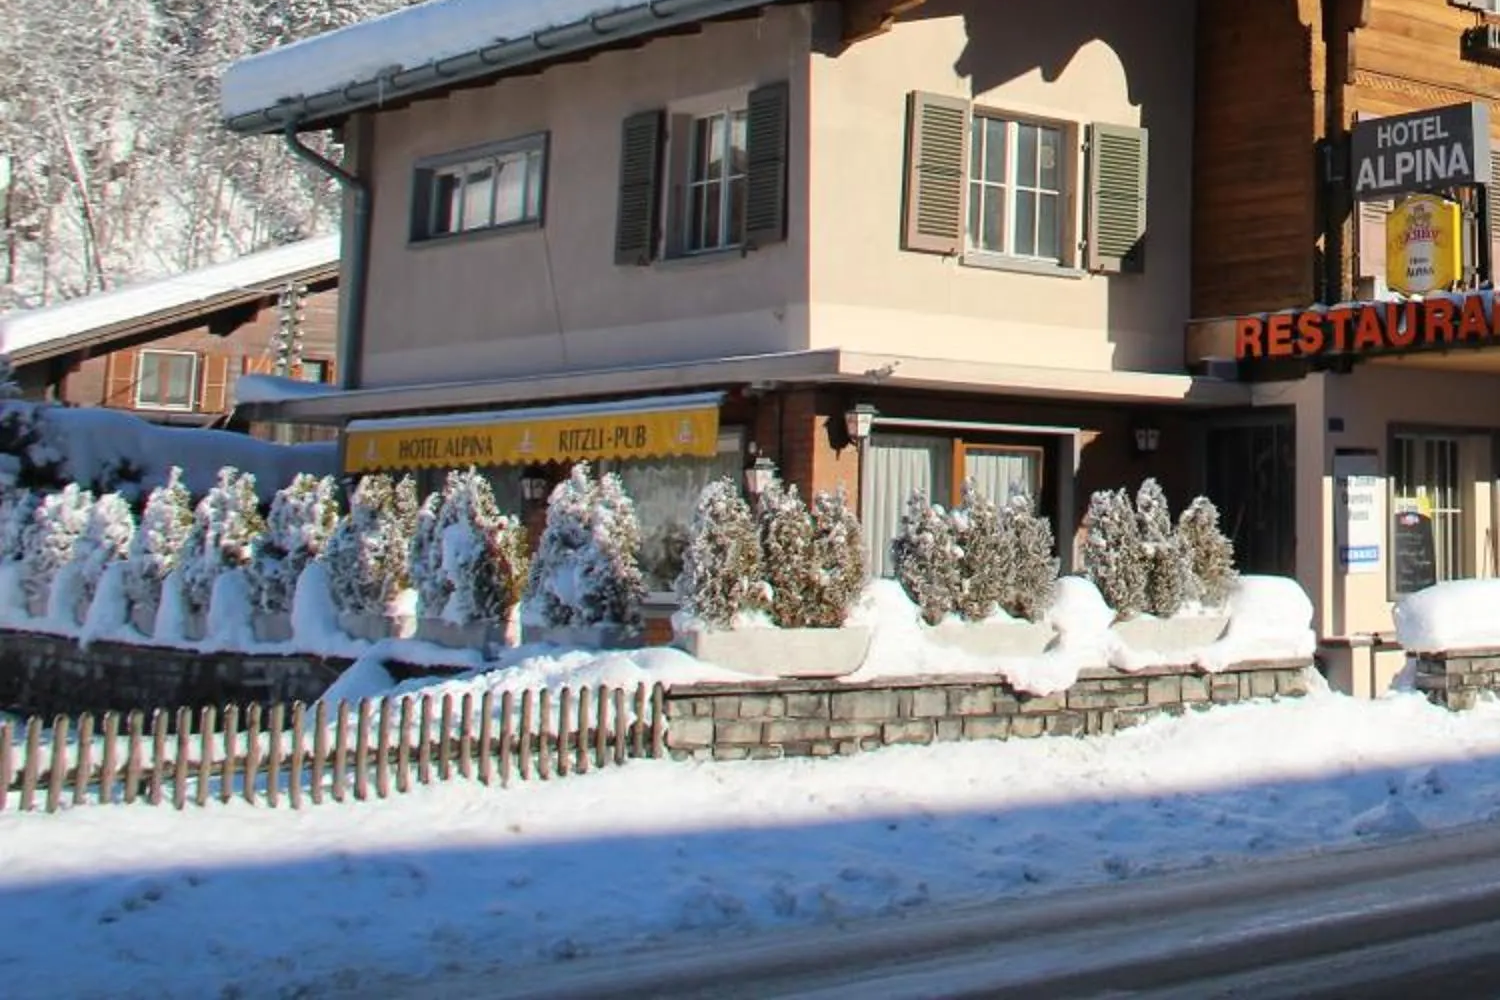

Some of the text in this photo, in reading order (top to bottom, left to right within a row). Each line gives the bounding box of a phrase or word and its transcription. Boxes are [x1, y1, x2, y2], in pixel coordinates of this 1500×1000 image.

[1377, 115, 1449, 149] HOTEL
[1355, 141, 1470, 192] ALPINA
[399, 434, 493, 460] HOTEL ALPINA
